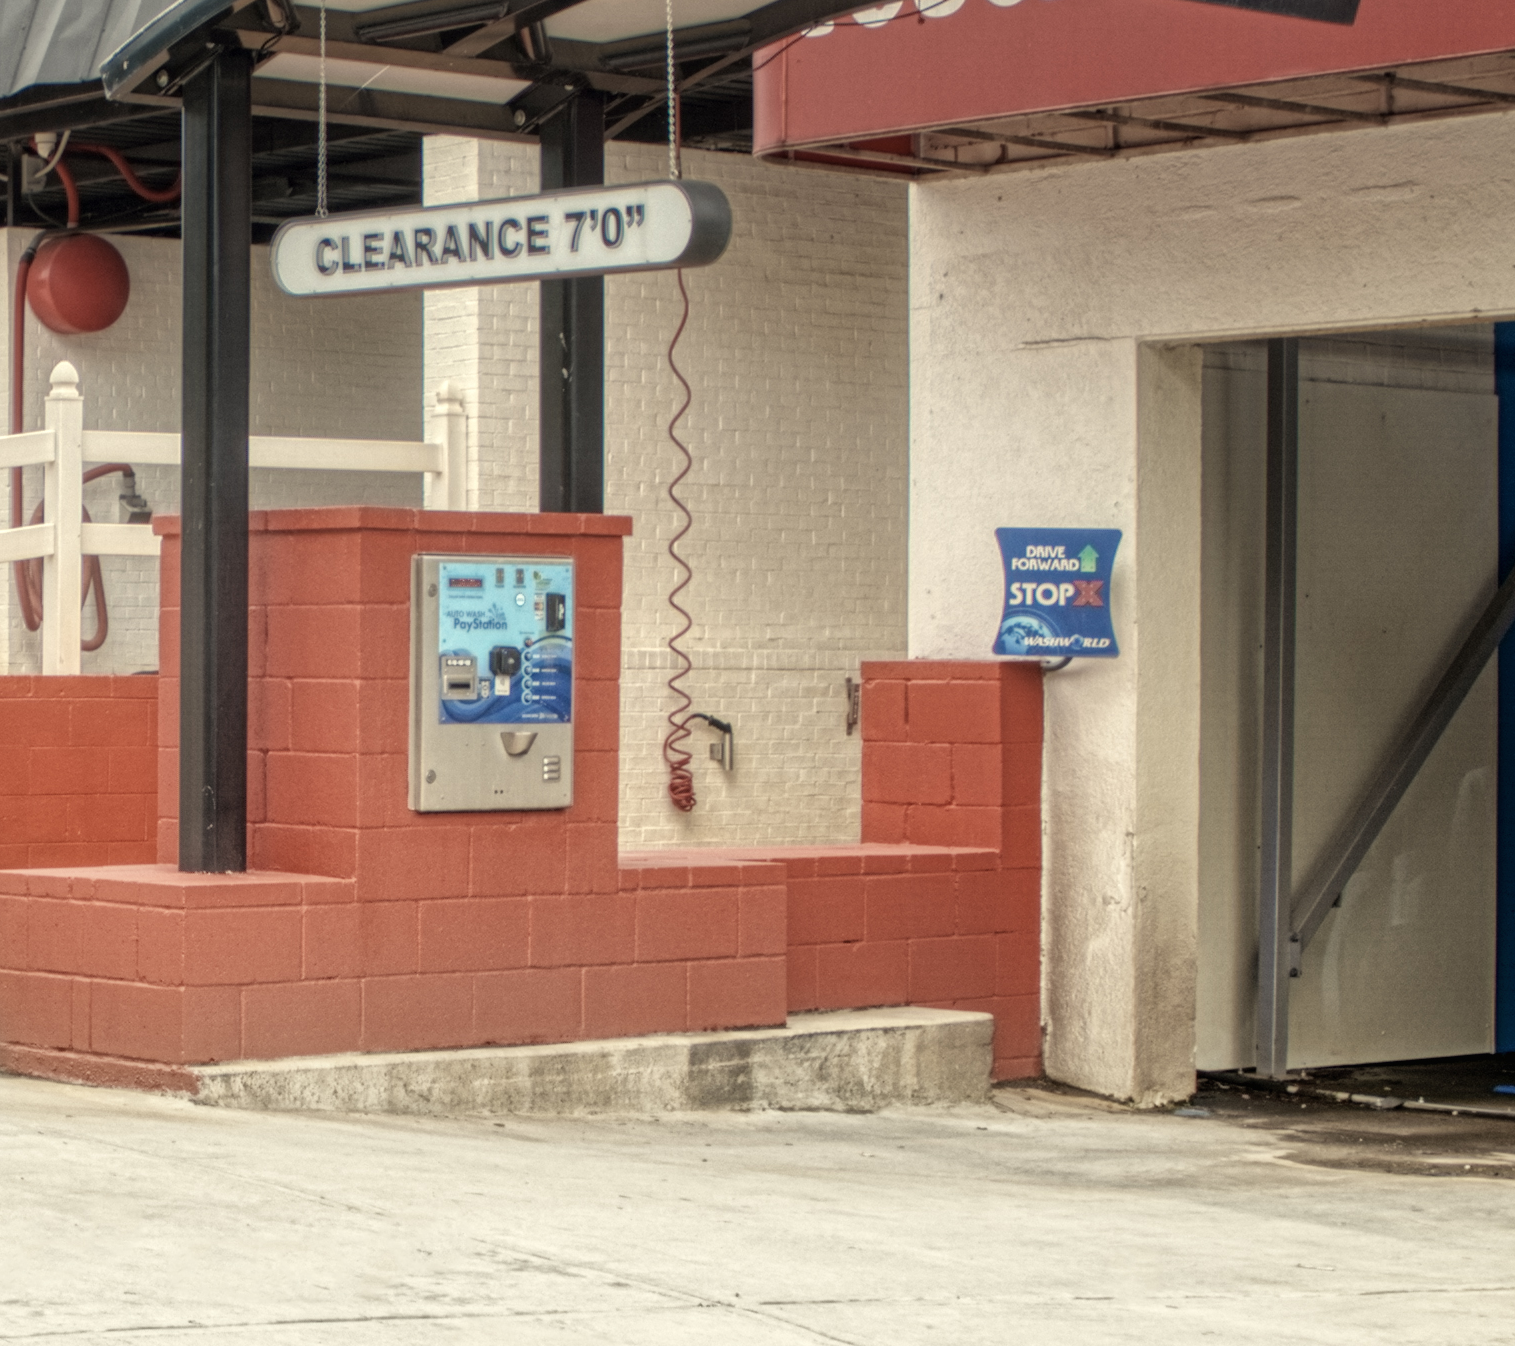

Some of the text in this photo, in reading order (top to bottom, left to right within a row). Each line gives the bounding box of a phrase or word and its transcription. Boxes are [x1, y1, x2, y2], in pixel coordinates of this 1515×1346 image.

[314, 215, 551, 277] CLEARANCE
[1026, 545, 1066, 558] DRIVE
[1011, 558, 1080, 571] FORWARD
[1009, 582, 1076, 606] STOP
[446, 610, 486, 618] AUTO WASH
